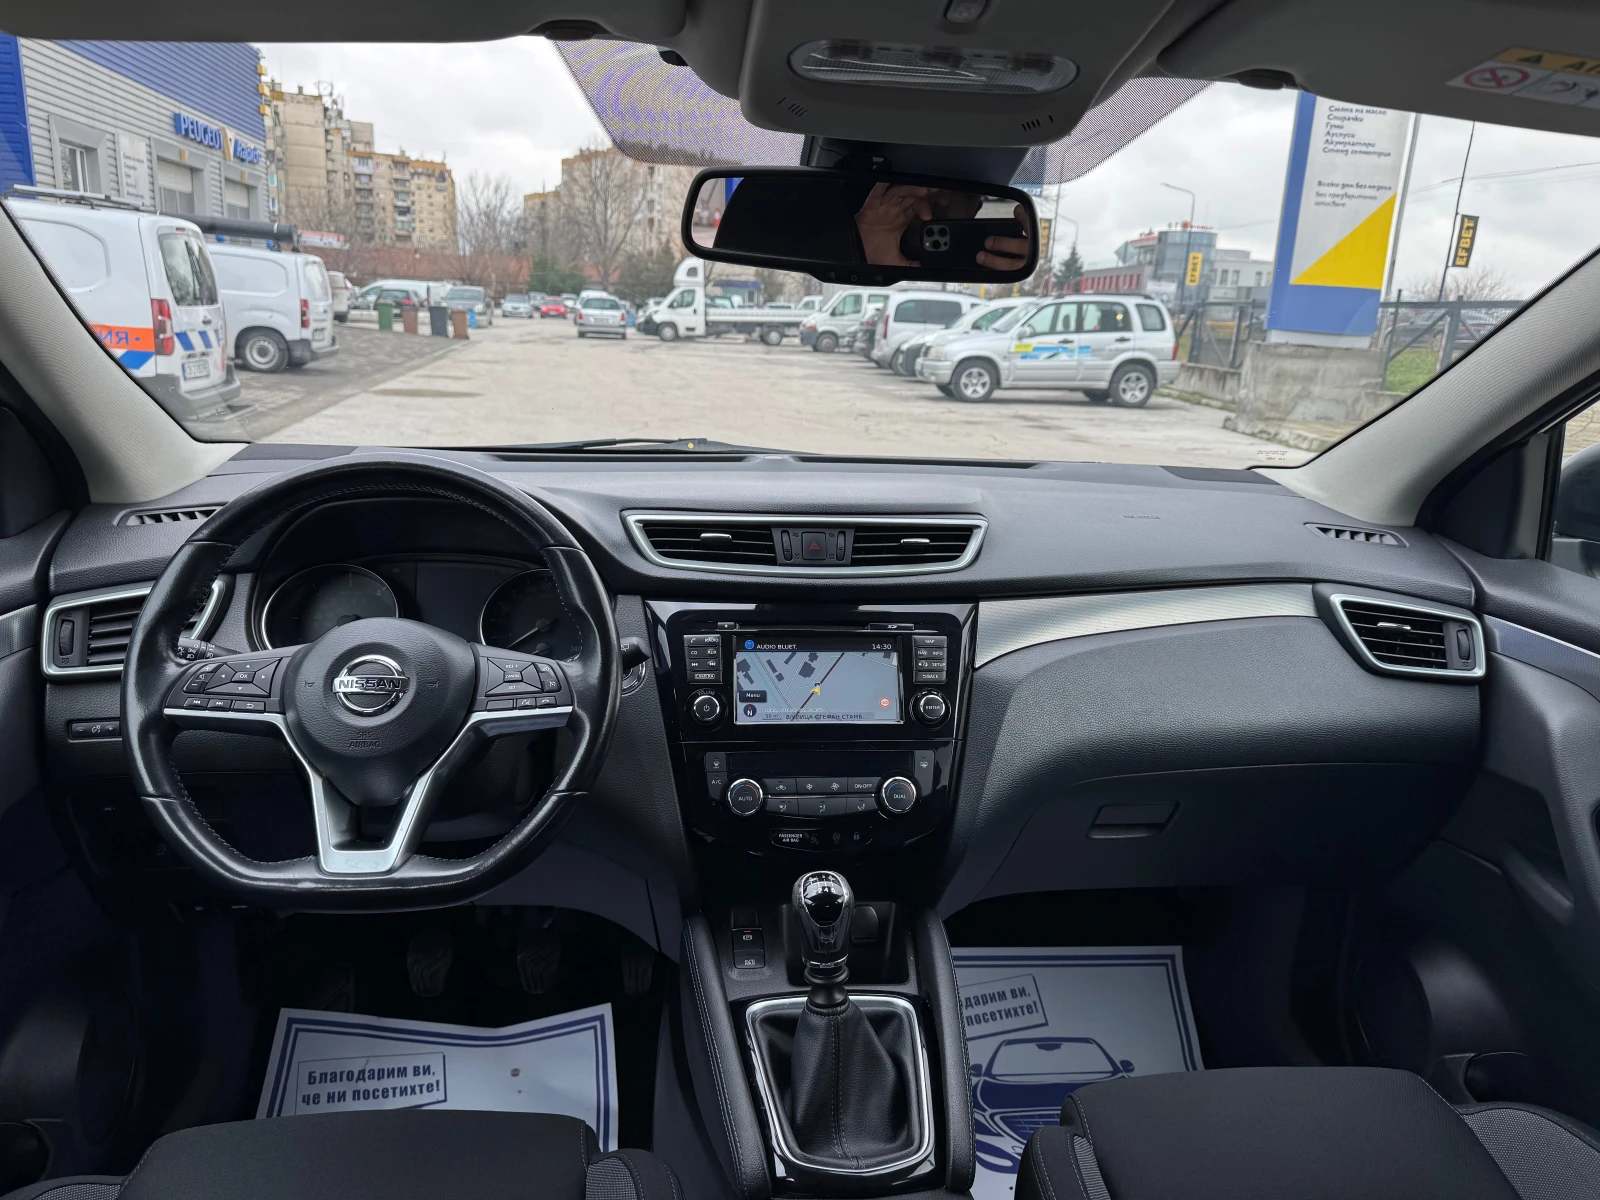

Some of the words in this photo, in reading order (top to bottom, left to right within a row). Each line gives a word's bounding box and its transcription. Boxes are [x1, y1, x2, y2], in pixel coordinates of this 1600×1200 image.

[1327, 113, 1364, 123] Спирачки
[180, 114, 224, 150] PEUGEOT
[1325, 130, 1355, 139] Ауспуси
[1323, 138, 1376, 148] Акумулатори
[1322, 146, 1349, 156] Стенд
[1455, 217, 1475, 266] EFBET
[338, 679, 401, 691] NISSAN
[349, 741, 381, 749] AIRBAG
[965, 1000, 1039, 1027] посетихте!
[307, 1065, 408, 1086] Благодарим
[412, 1064, 436, 1077] ви,
[301, 1092, 321, 1106] че
[326, 1089, 347, 1104] ни
[352, 1079, 441, 1102] посетихте!
